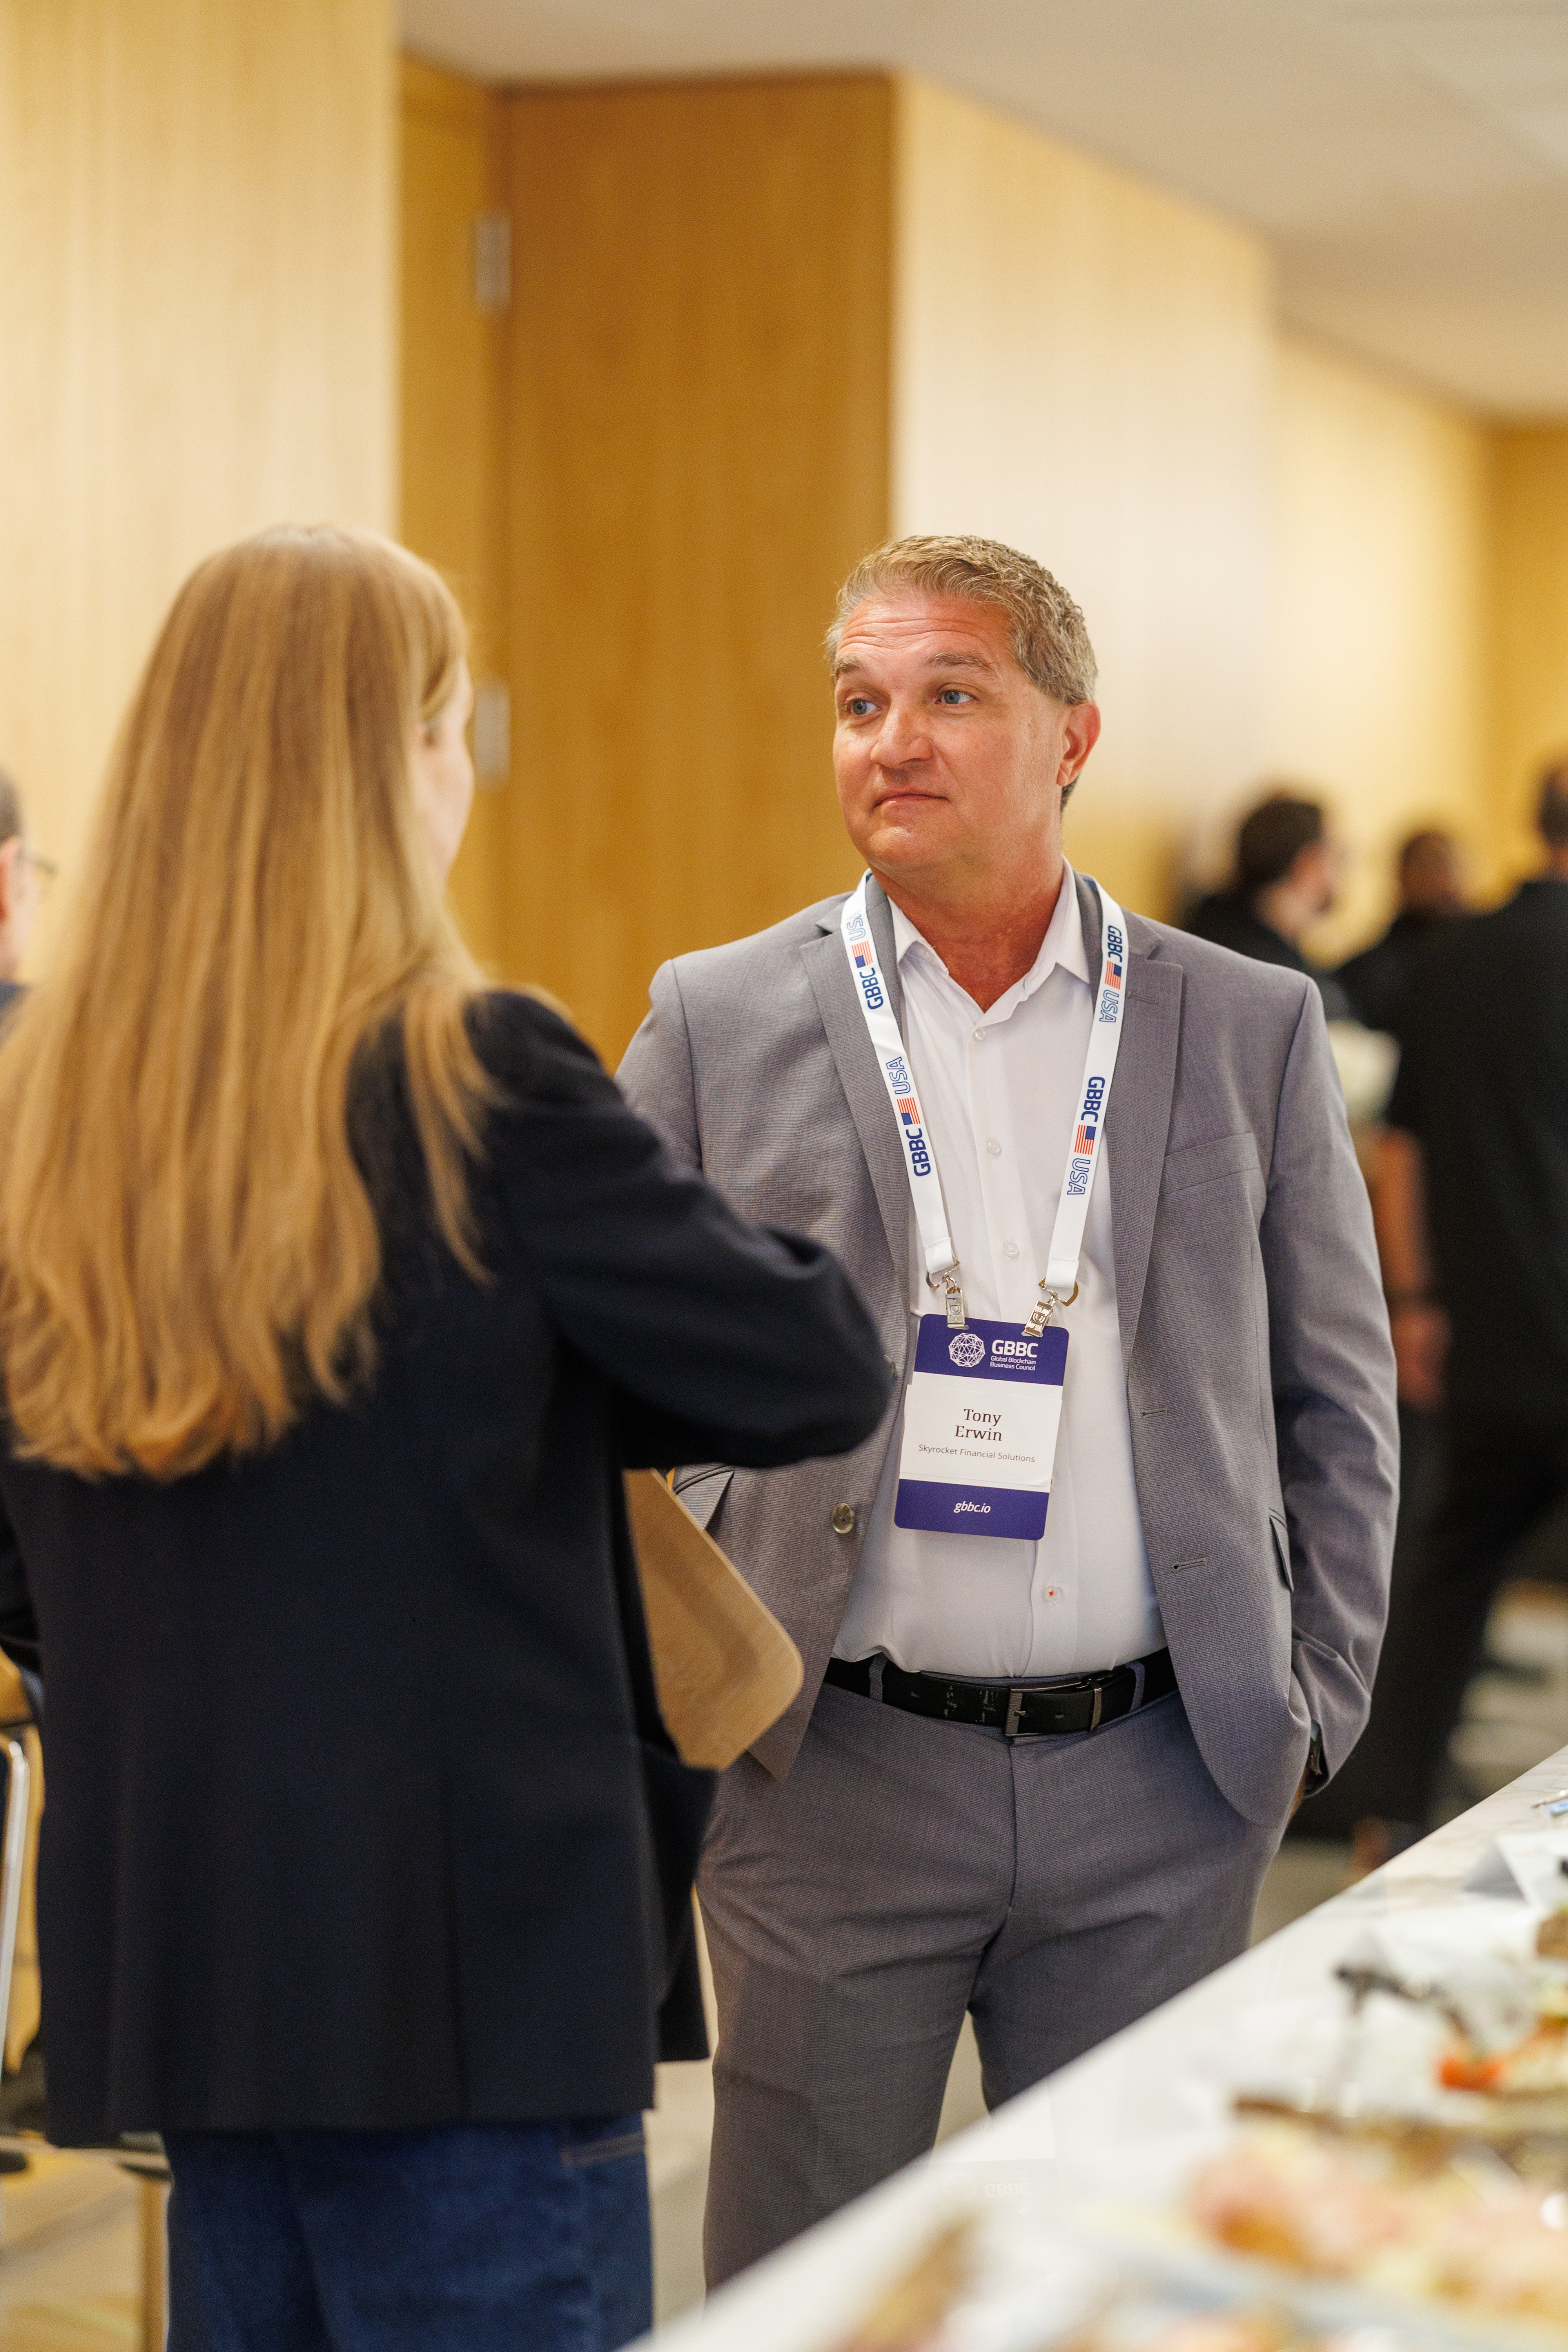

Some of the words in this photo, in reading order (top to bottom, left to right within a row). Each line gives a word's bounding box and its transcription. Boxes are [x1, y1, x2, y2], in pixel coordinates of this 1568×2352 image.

[1107, 925, 1123, 963] GBBC
[859, 967, 884, 1010] GBBC
[1099, 989, 1120, 1023] USA
[886, 1056, 911, 1094] USA
[1081, 1076, 1105, 1122] GBBC
[906, 1128, 931, 1177] GBBC
[1067, 1158, 1091, 1195] USA
[991, 1339, 1039, 1358] GBBC
[1008, 1357, 1036, 1365] Blockchain
[954, 1425, 1002, 1441] Erwin
[964, 1408, 1002, 1426] Tony
[918, 1444, 958, 1454] Skyrocket
[960, 1448, 996, 1458] Financial
[998, 1452, 1035, 1463] Solutions
[953, 1501, 991, 1513] gbbc.io
